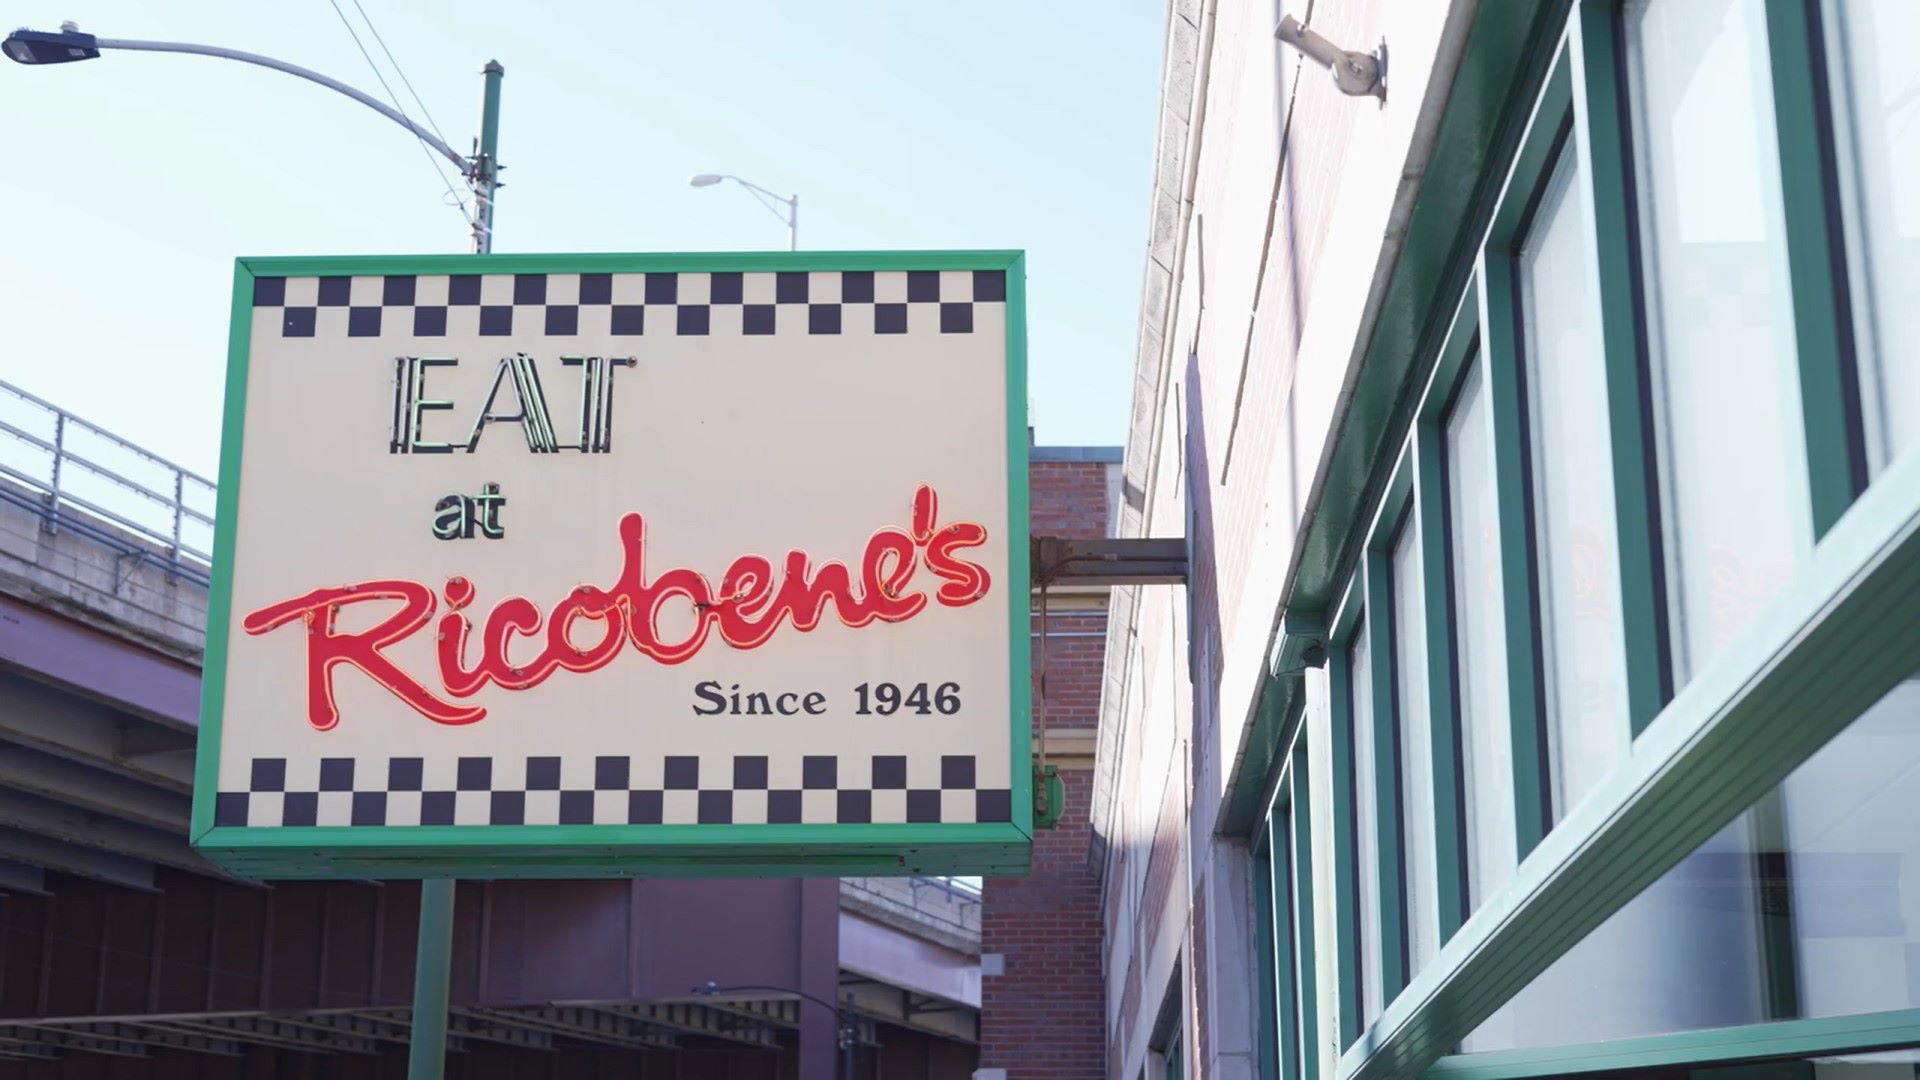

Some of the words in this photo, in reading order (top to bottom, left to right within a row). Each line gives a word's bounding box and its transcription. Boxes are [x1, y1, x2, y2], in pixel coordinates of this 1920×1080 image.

[390, 353, 637, 454] EAT
[432, 483, 506, 540] at
[242, 482, 991, 731] Ricobene's
[692, 681, 828, 716] Since
[854, 682, 962, 716] 1946
